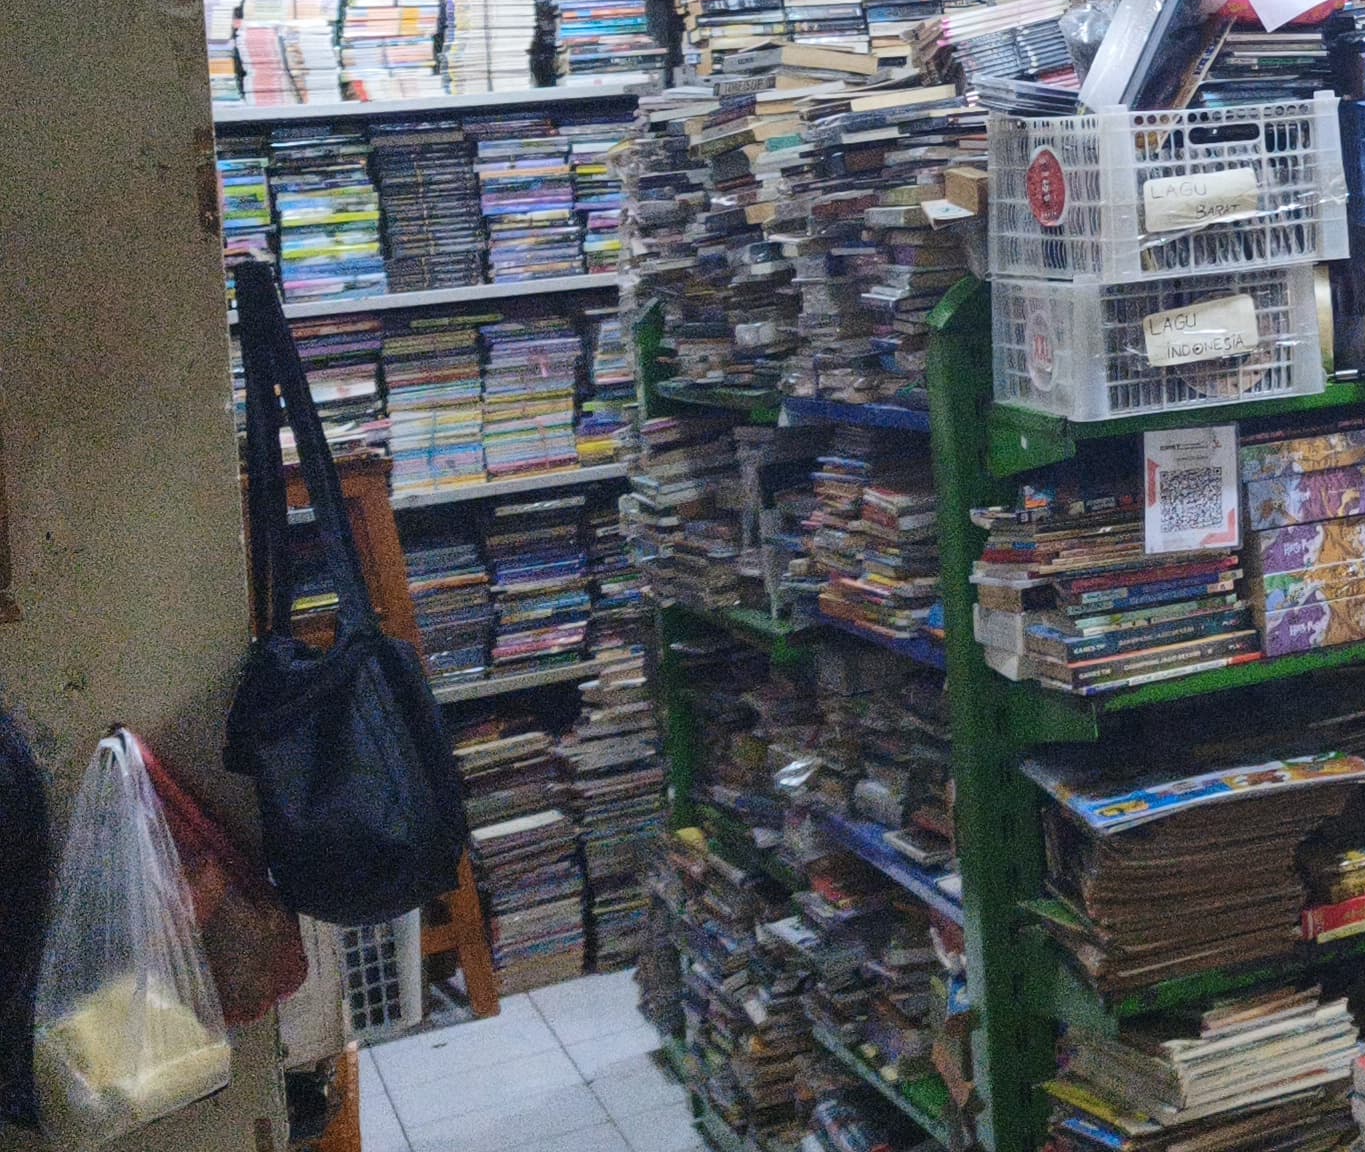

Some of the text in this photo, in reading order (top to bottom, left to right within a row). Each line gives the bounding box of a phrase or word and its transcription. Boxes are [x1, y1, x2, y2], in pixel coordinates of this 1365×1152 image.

[1150, 182, 1208, 200] LAGU
[1196, 204, 1240, 219] BARAT
[1148, 312, 1197, 336] LAGU
